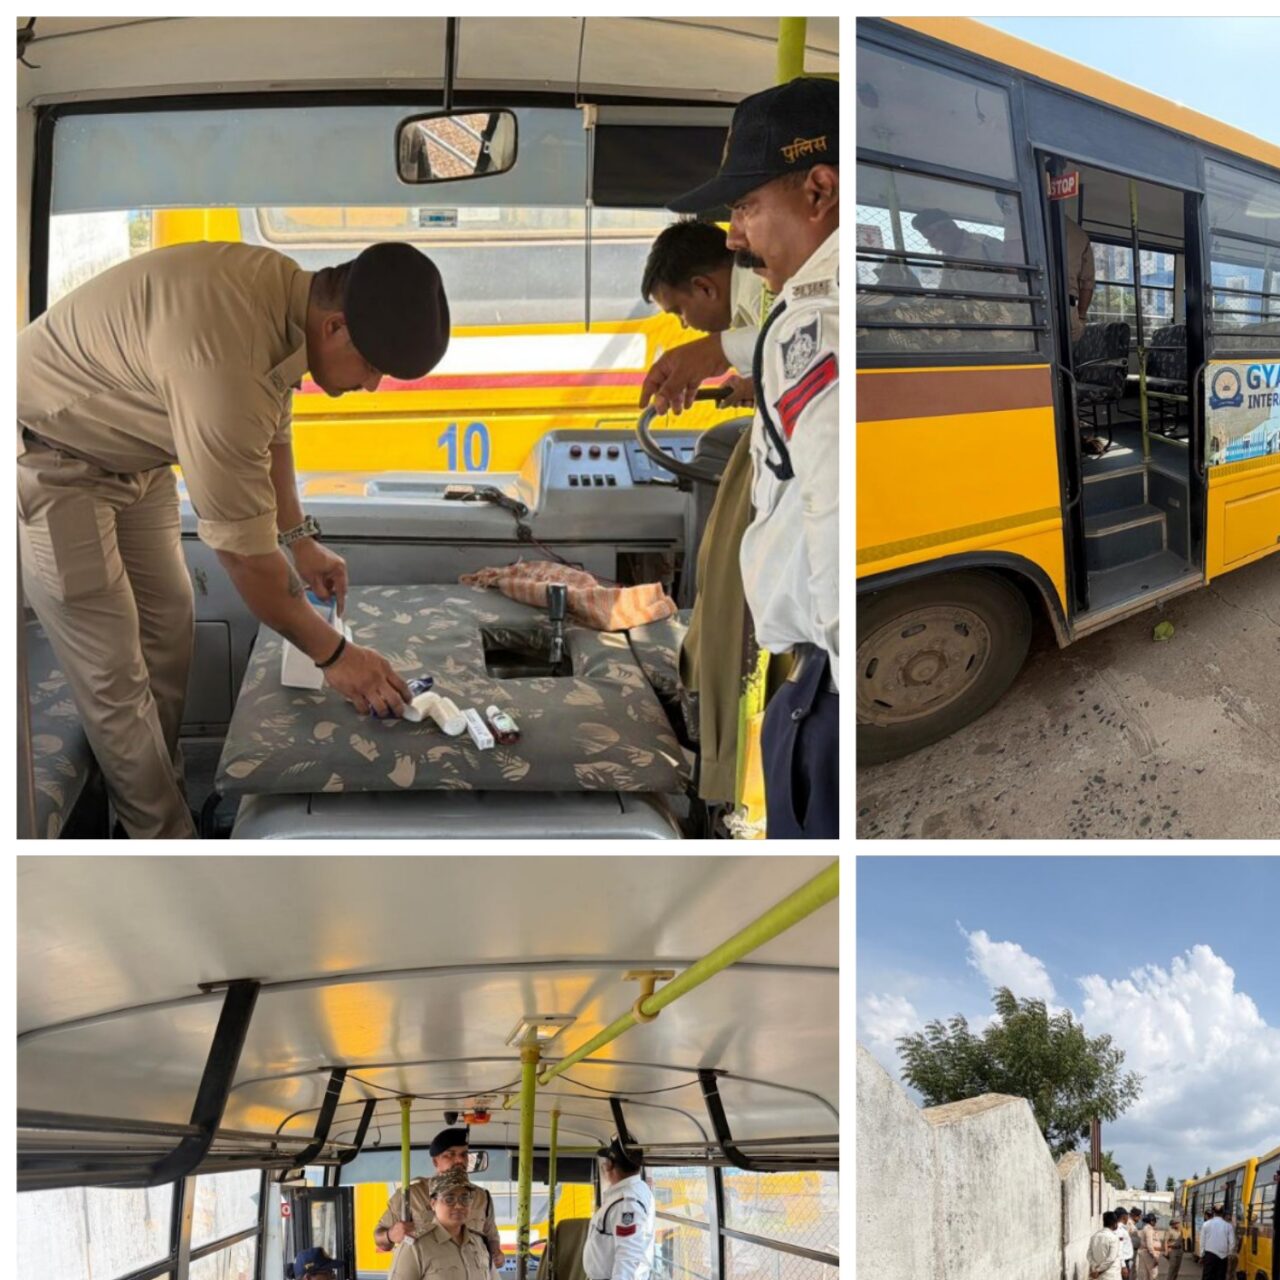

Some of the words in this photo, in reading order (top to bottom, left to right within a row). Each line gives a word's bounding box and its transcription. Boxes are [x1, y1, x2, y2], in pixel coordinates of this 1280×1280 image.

[781, 135, 827, 164] पुलिस
[1050, 176, 1075, 196] STOP
[438, 421, 490, 473] 10
